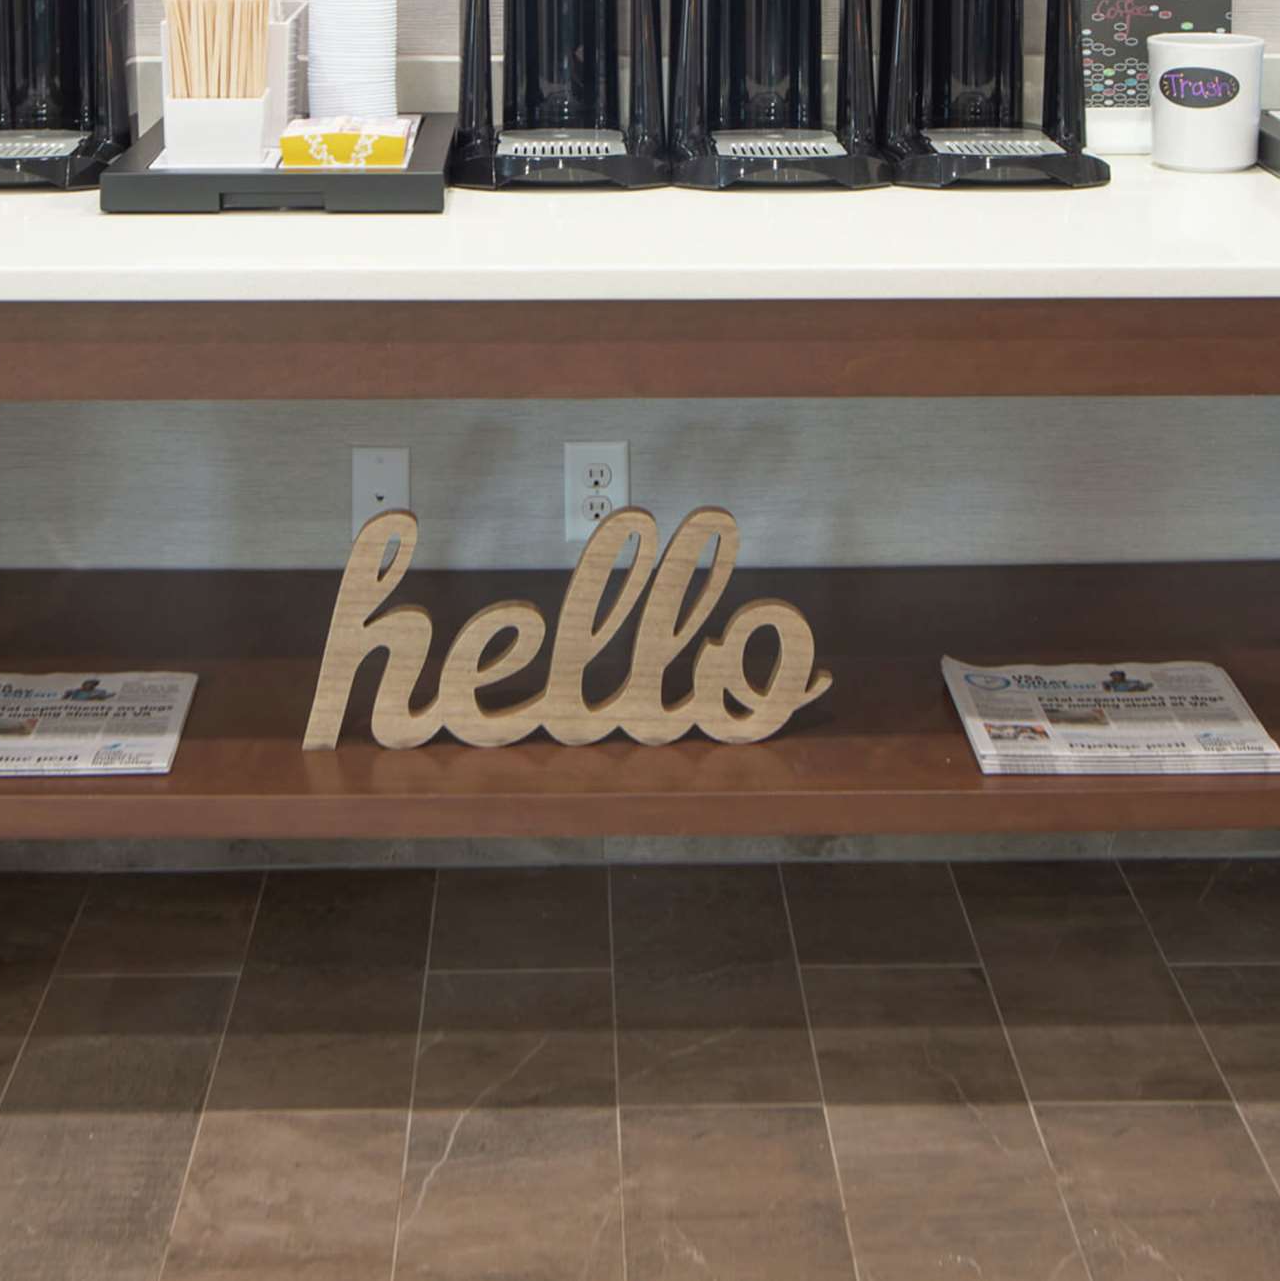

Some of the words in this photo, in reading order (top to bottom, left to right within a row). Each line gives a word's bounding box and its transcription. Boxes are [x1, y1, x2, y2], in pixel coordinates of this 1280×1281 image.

[1166, 73, 1232, 99] Trash
[302, 506, 834, 751] hello
[1076, 695, 1165, 703] experiments
[1189, 694, 1224, 702] dogs
[23, 704, 113, 713] experiments
[139, 704, 174, 712] dogs
